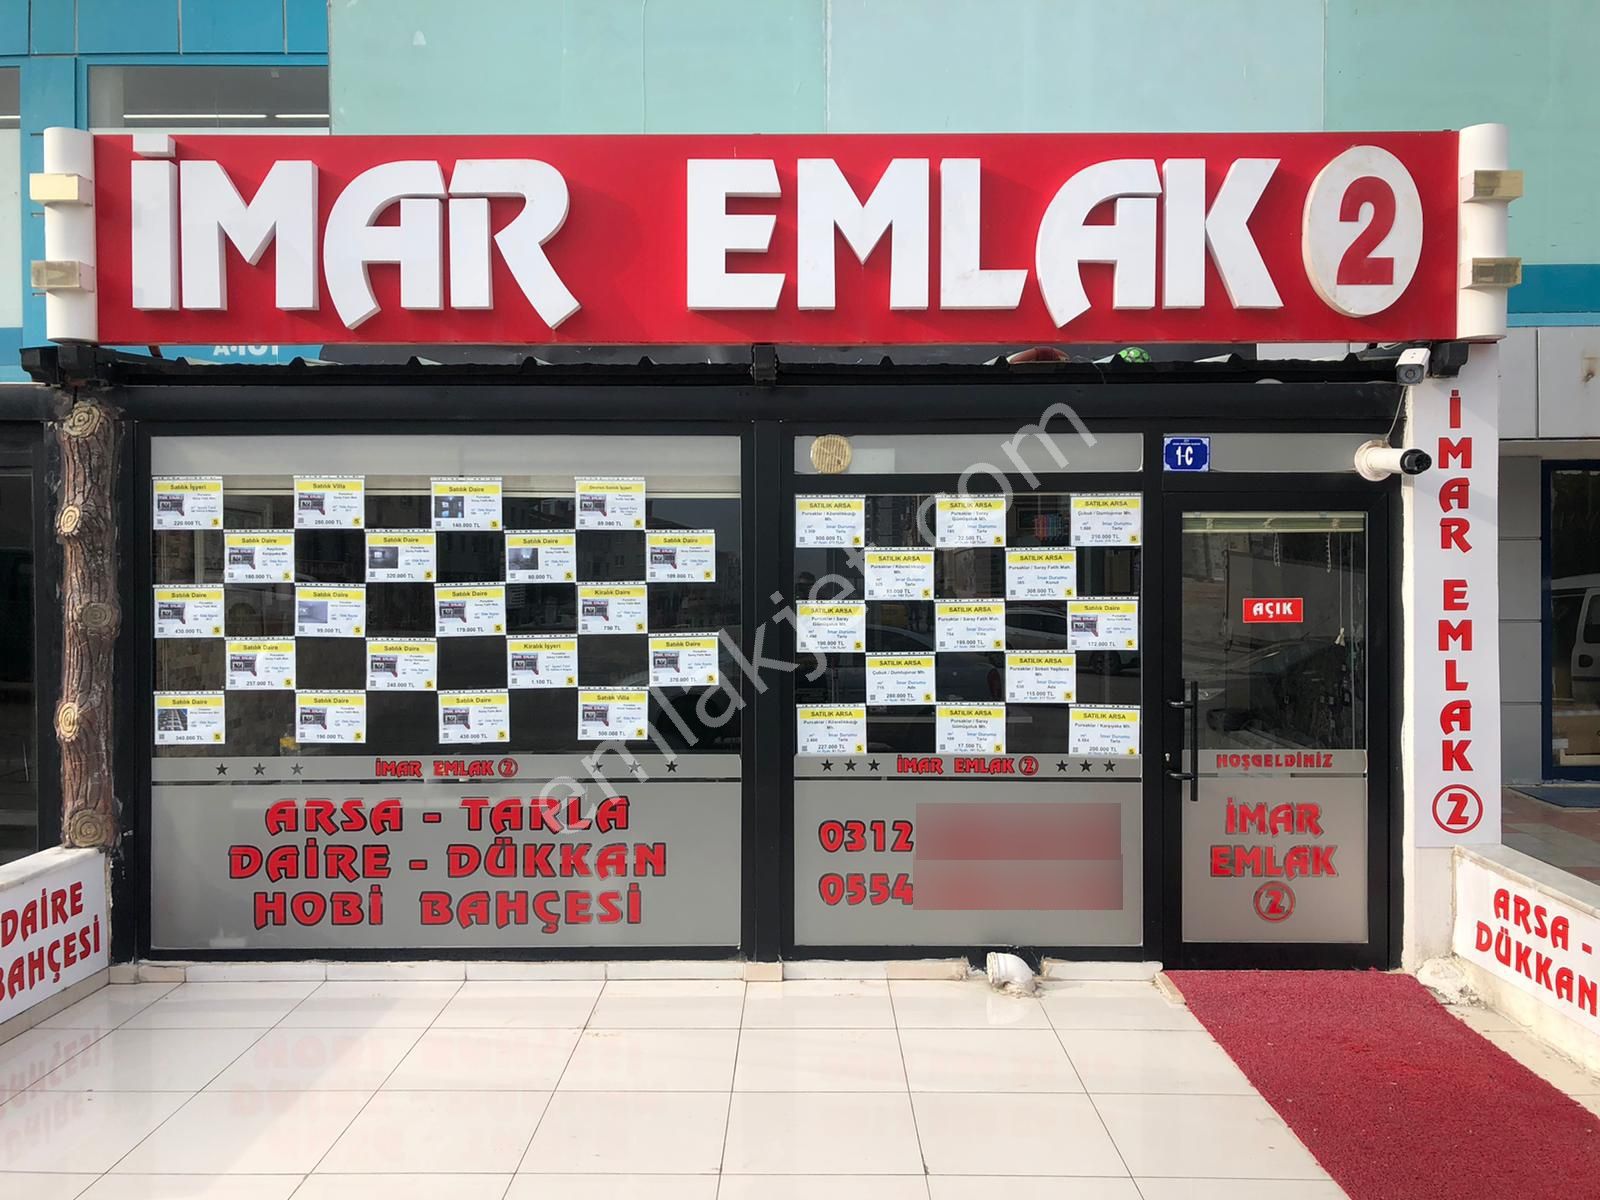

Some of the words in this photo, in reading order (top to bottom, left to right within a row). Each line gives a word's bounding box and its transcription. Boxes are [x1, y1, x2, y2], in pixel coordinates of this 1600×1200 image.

[131, 134, 582, 330] İMAR
[687, 157, 1284, 329] EMLAK
[1336, 176, 1395, 286] 2
[1175, 446, 1193, 466] 1-C
[1438, 389, 1473, 553] İMAR
[191, 483, 207, 491] İşyeri
[1253, 602, 1293, 619] AÇIK
[544, 642, 561, 650] İşyeri
[1438, 579, 1473, 771] EMLAK
[375, 757, 422, 778] İMAR
[433, 760, 494, 777] EMLAK
[896, 754, 944, 775] İMAR
[954, 758, 1015, 775] EMLAK
[1216, 752, 1333, 771] HOŞGELDİNİZ
[265, 796, 404, 835] ARSA
[459, 796, 630, 835] TARLA
[1225, 797, 1324, 838] İMAR
[818, 820, 914, 853] 0312
[228, 838, 391, 883] DAİRE
[447, 838, 667, 881] DÜKKAN
[1210, 844, 1339, 880] EMLAK
[818, 873, 914, 905] 0554
[0, 881, 83, 948] DAİRE
[253, 884, 382, 929] HOBİ
[419, 883, 642, 934] BAHÇESİ
[1494, 888, 1569, 951] ARSA
[1475, 920, 1597, 1017] DÜKKAN
